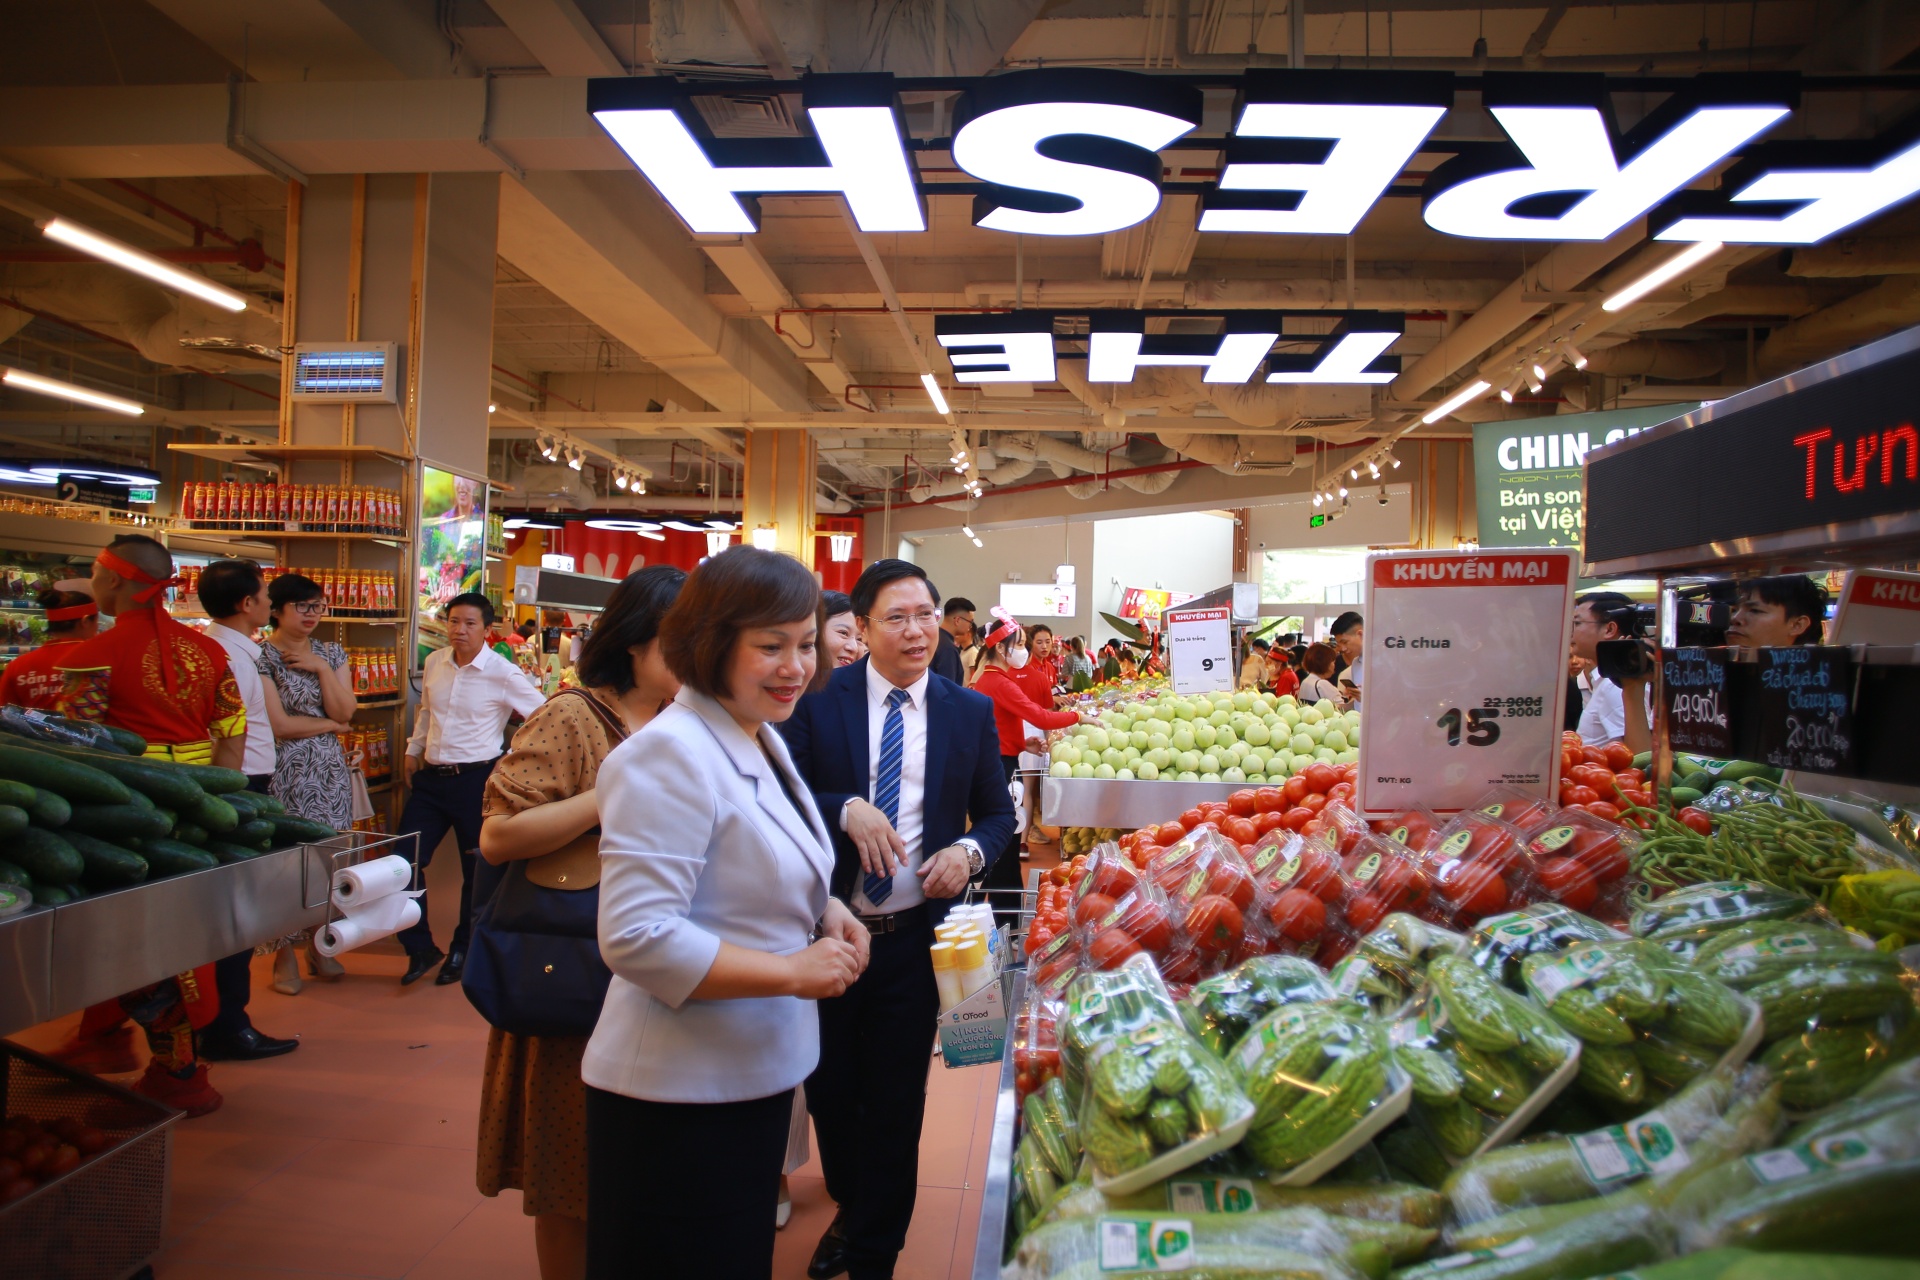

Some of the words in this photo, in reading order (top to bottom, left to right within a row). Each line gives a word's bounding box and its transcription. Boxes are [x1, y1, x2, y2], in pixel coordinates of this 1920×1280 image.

[593, 102, 1920, 243] FRESH
[937, 331, 1402, 384] THE
[1497, 427, 1652, 471] CHIN-
[62, 482, 79, 501] 2
[1500, 488, 1540, 506] Bán
[1499, 513, 1527, 535] tại
[1530, 507, 1582, 535] Việt
[1393, 557, 1495, 580] KHUYẾN
[1501, 561, 1548, 583] MẠI
[1175, 612, 1206, 620] KHUYẾN
[1208, 612, 1222, 620] MẠI
[1384, 635, 1406, 649] Cà
[1410, 636, 1451, 649] chua
[1202, 658, 1214, 671] 9
[17, 670, 47, 686] Sẵn
[1483, 696, 1543, 707] 22.900đ
[1502, 706, 1543, 718] .900đ
[1436, 707, 1501, 747] 15
[1377, 776, 1398, 784] ĐVT:
